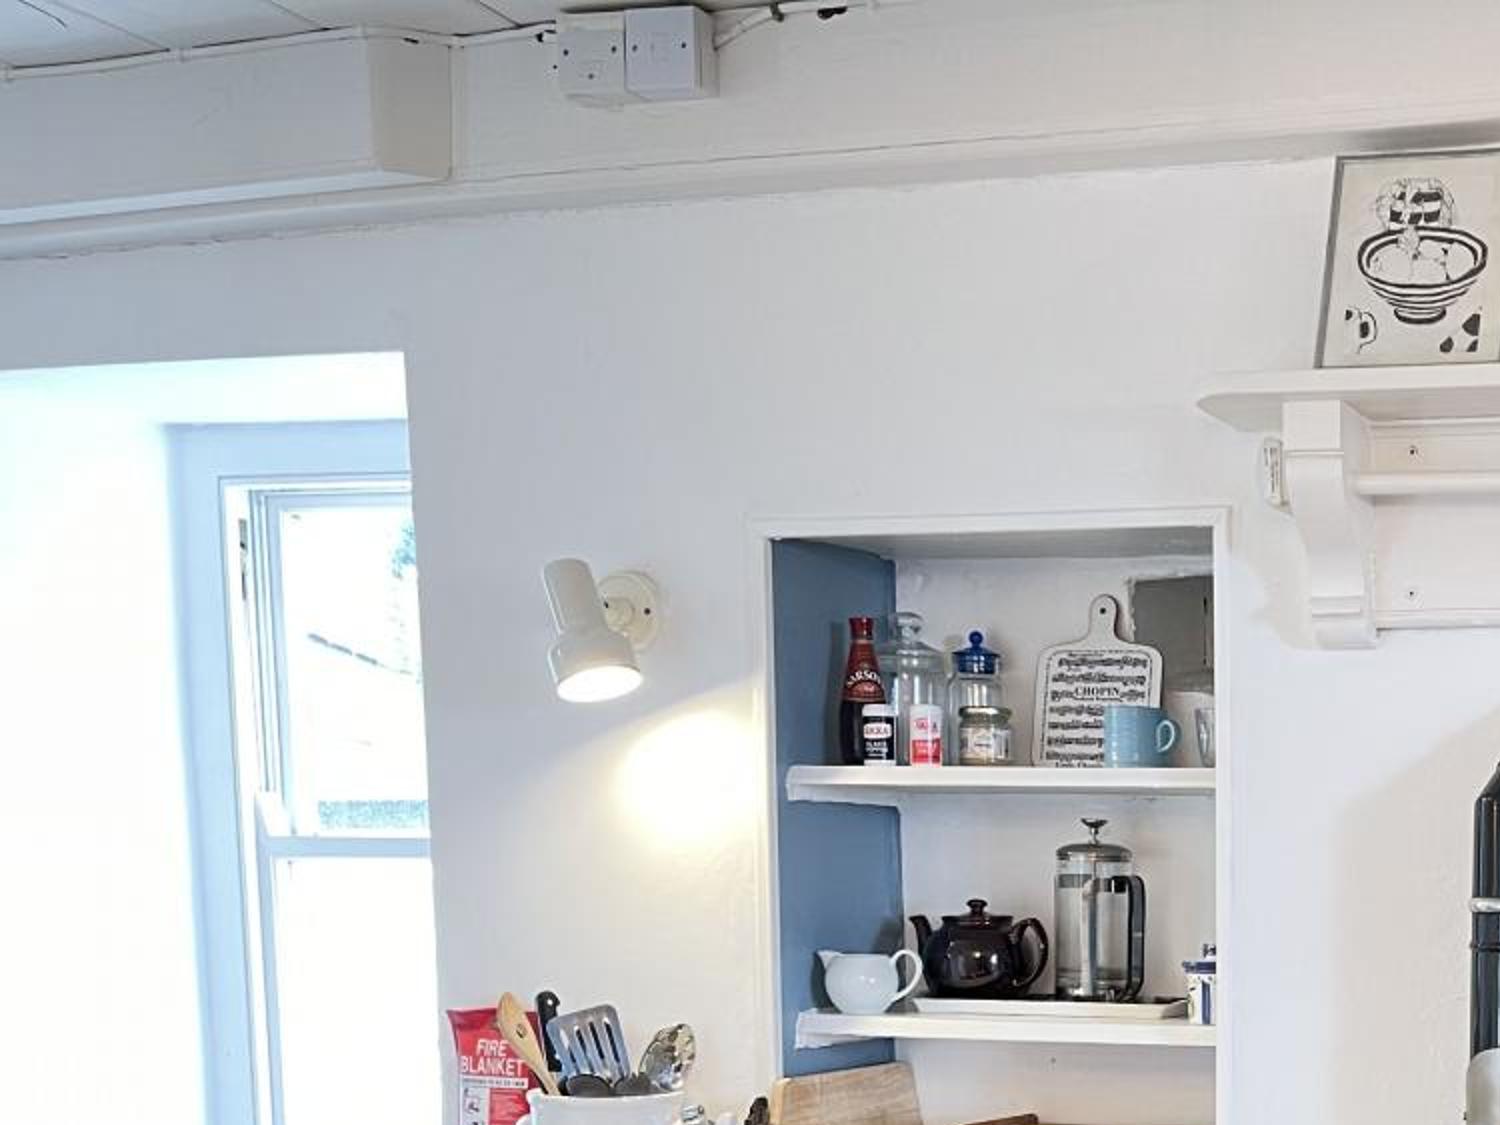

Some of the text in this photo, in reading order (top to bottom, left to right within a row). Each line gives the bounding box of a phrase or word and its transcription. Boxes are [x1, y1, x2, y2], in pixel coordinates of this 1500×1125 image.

[1075, 687, 1119, 697] CHOPIN
[475, 1039, 510, 1057] FIRE
[460, 1055, 525, 1077] BLANKET
